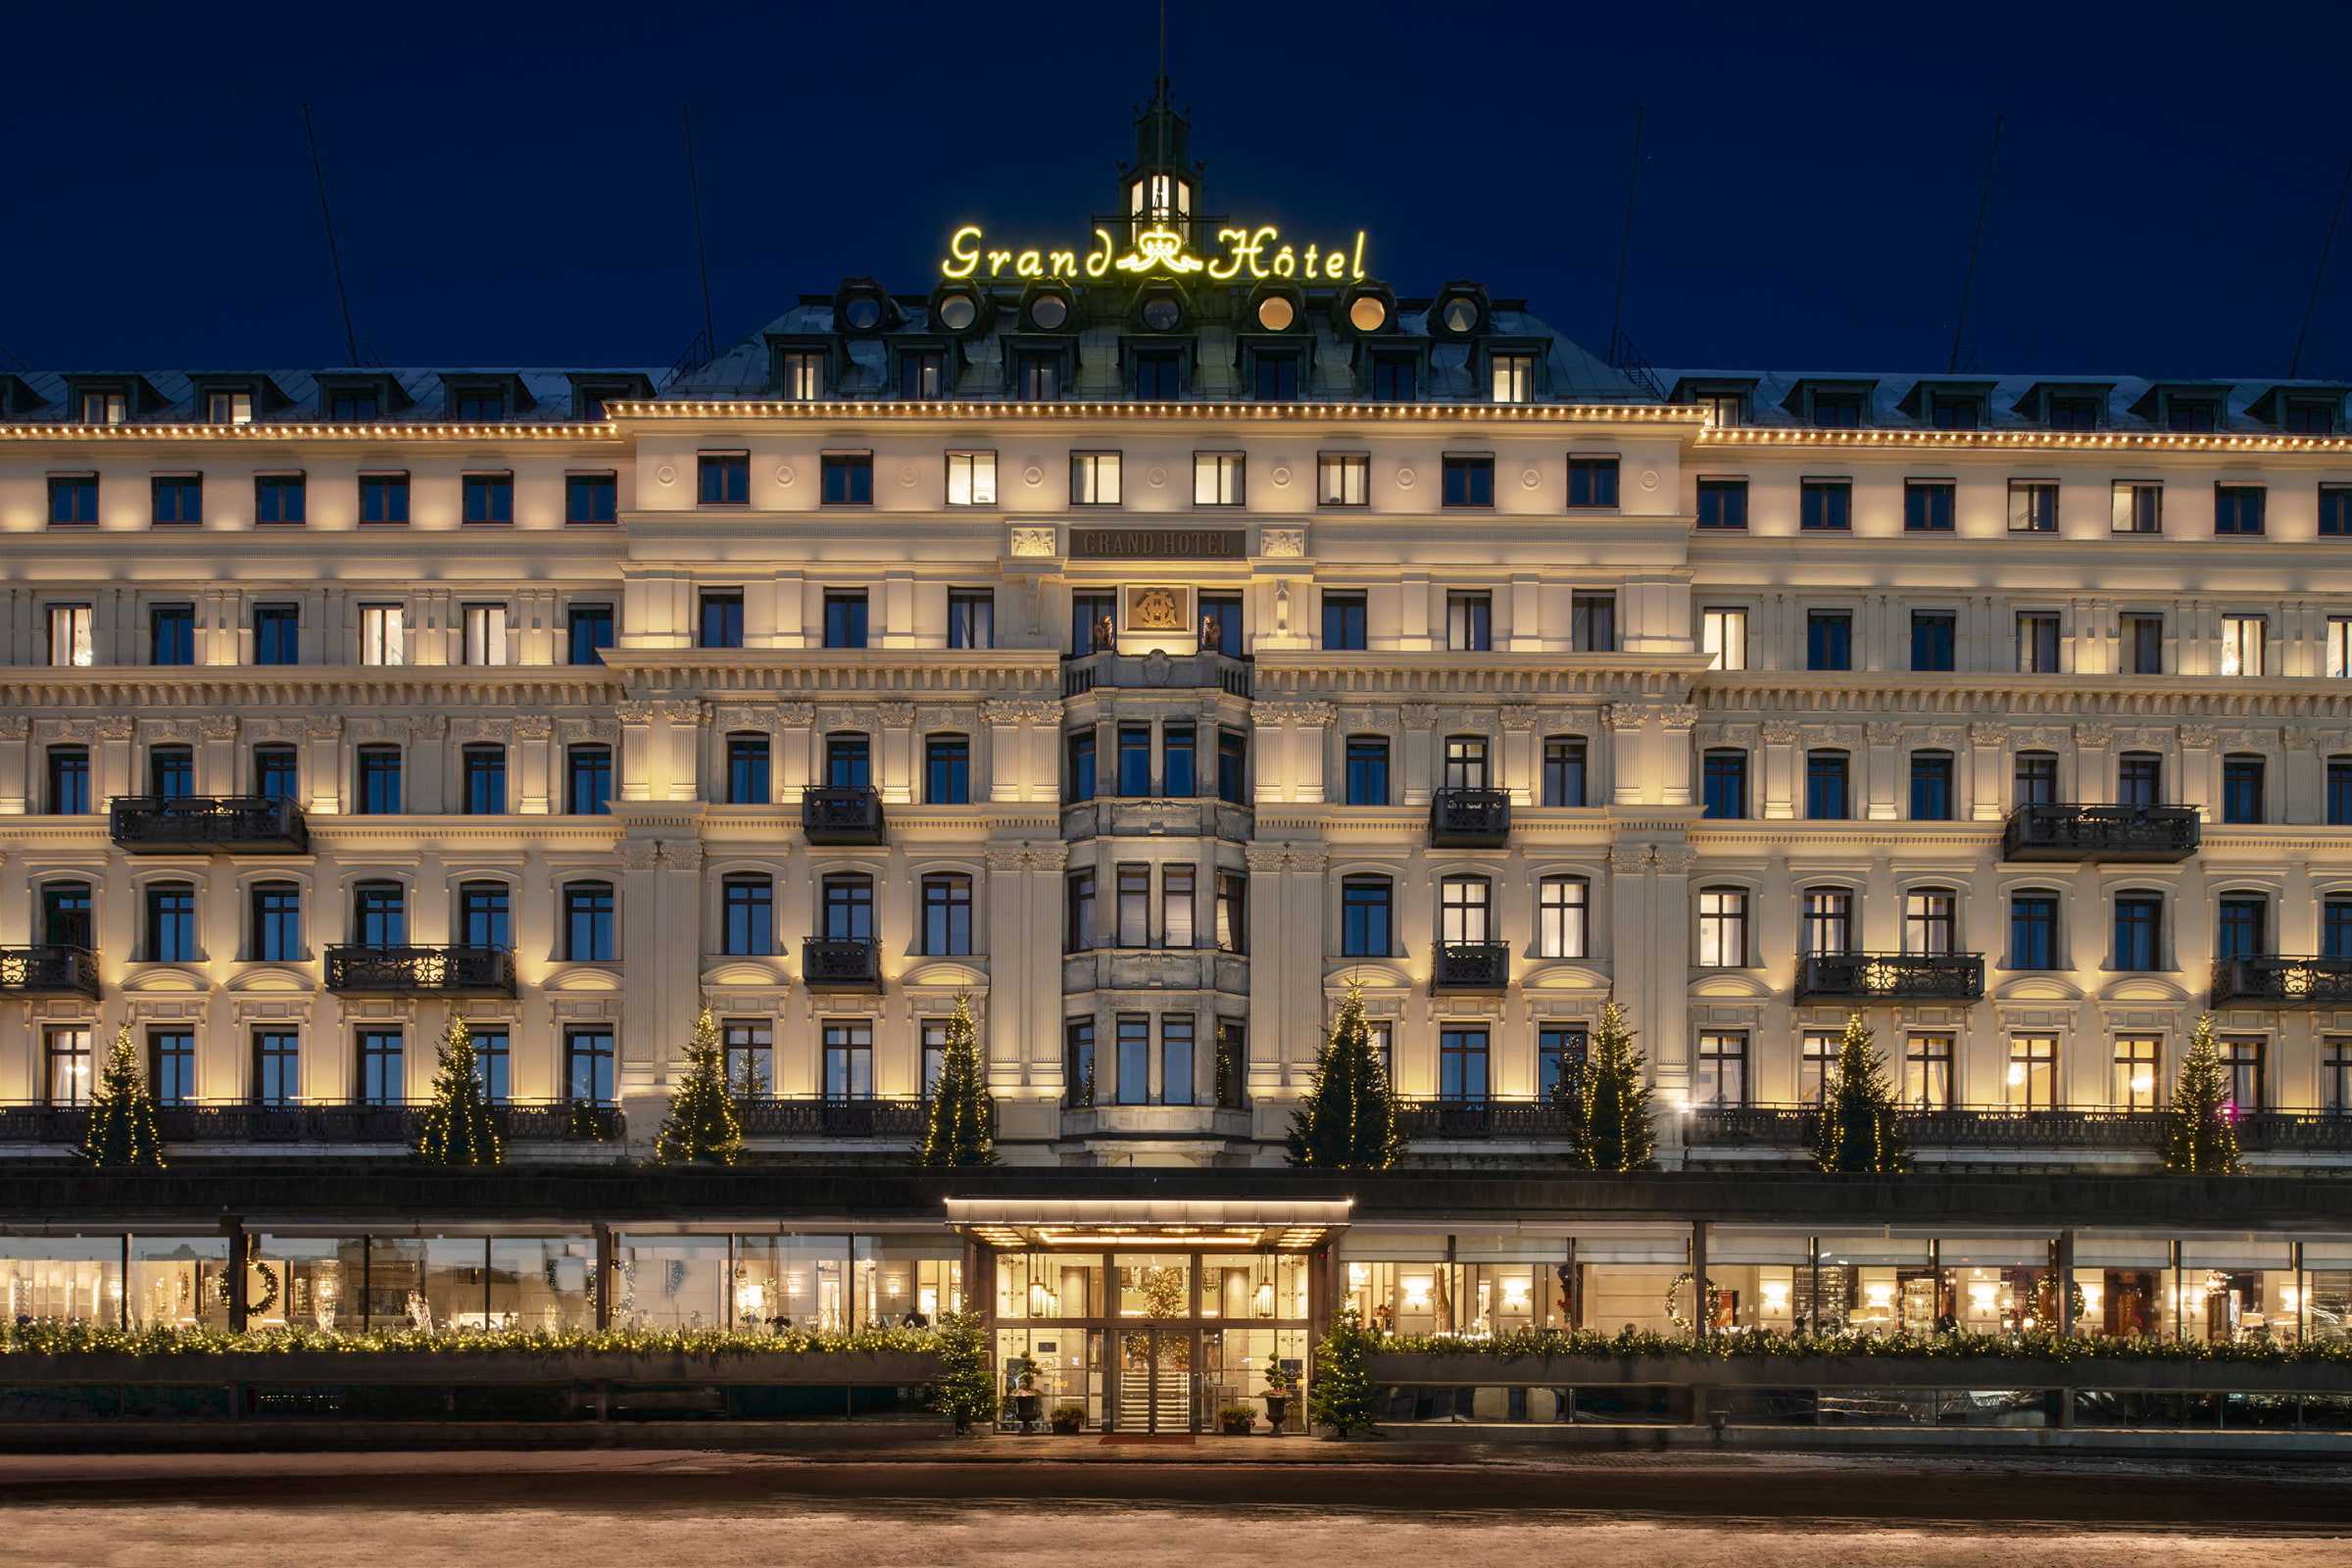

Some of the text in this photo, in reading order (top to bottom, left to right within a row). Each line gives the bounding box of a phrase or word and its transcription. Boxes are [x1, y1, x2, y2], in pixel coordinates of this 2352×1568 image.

[942, 226, 1365, 278] Grand Hôtel
[1083, 529, 1231, 555] GRAND HÔTEL
